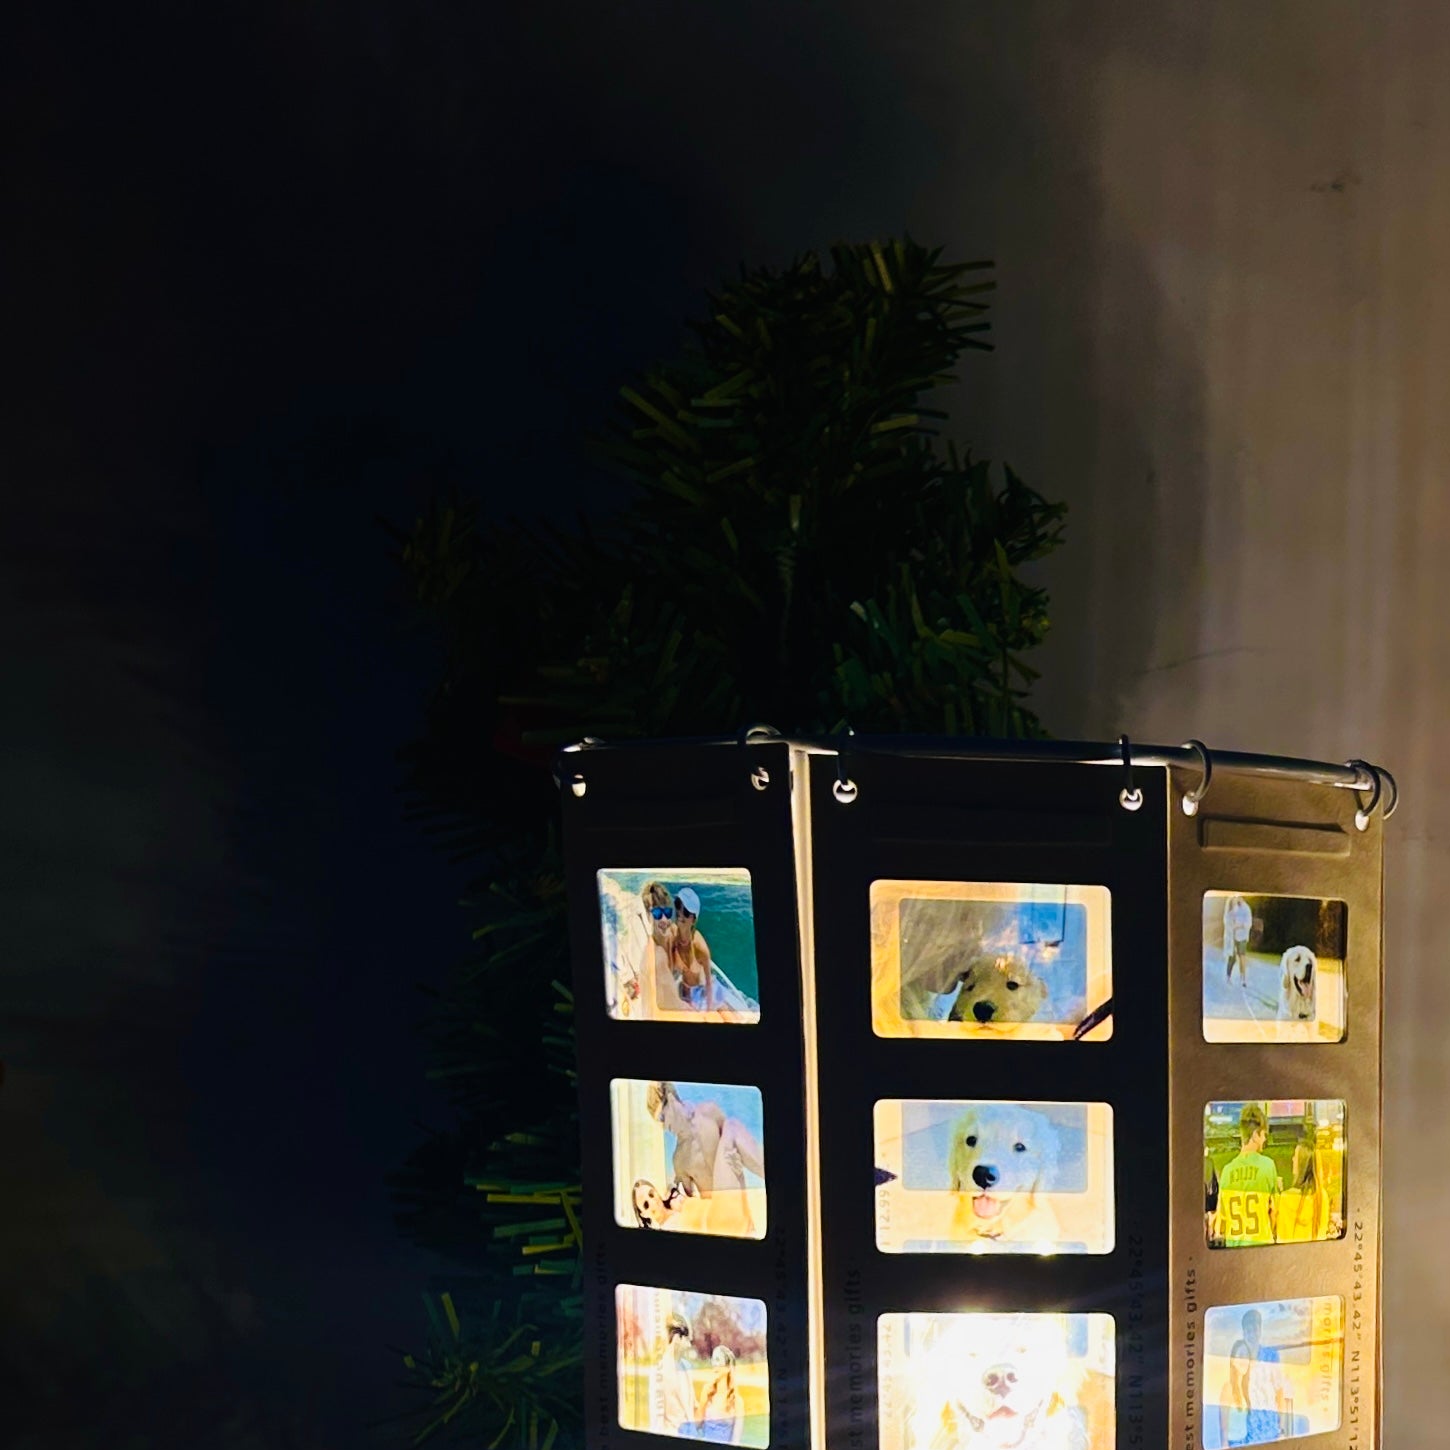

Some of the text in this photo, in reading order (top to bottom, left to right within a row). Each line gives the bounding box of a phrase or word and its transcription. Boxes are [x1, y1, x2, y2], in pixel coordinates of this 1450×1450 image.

[843, 1268, 865, 1315] gifts
[1182, 1268, 1198, 1313] gifts
[846, 1323, 864, 1423] memories
[1183, 1321, 1196, 1417] memories
[597, 1397, 610, 1436] best
